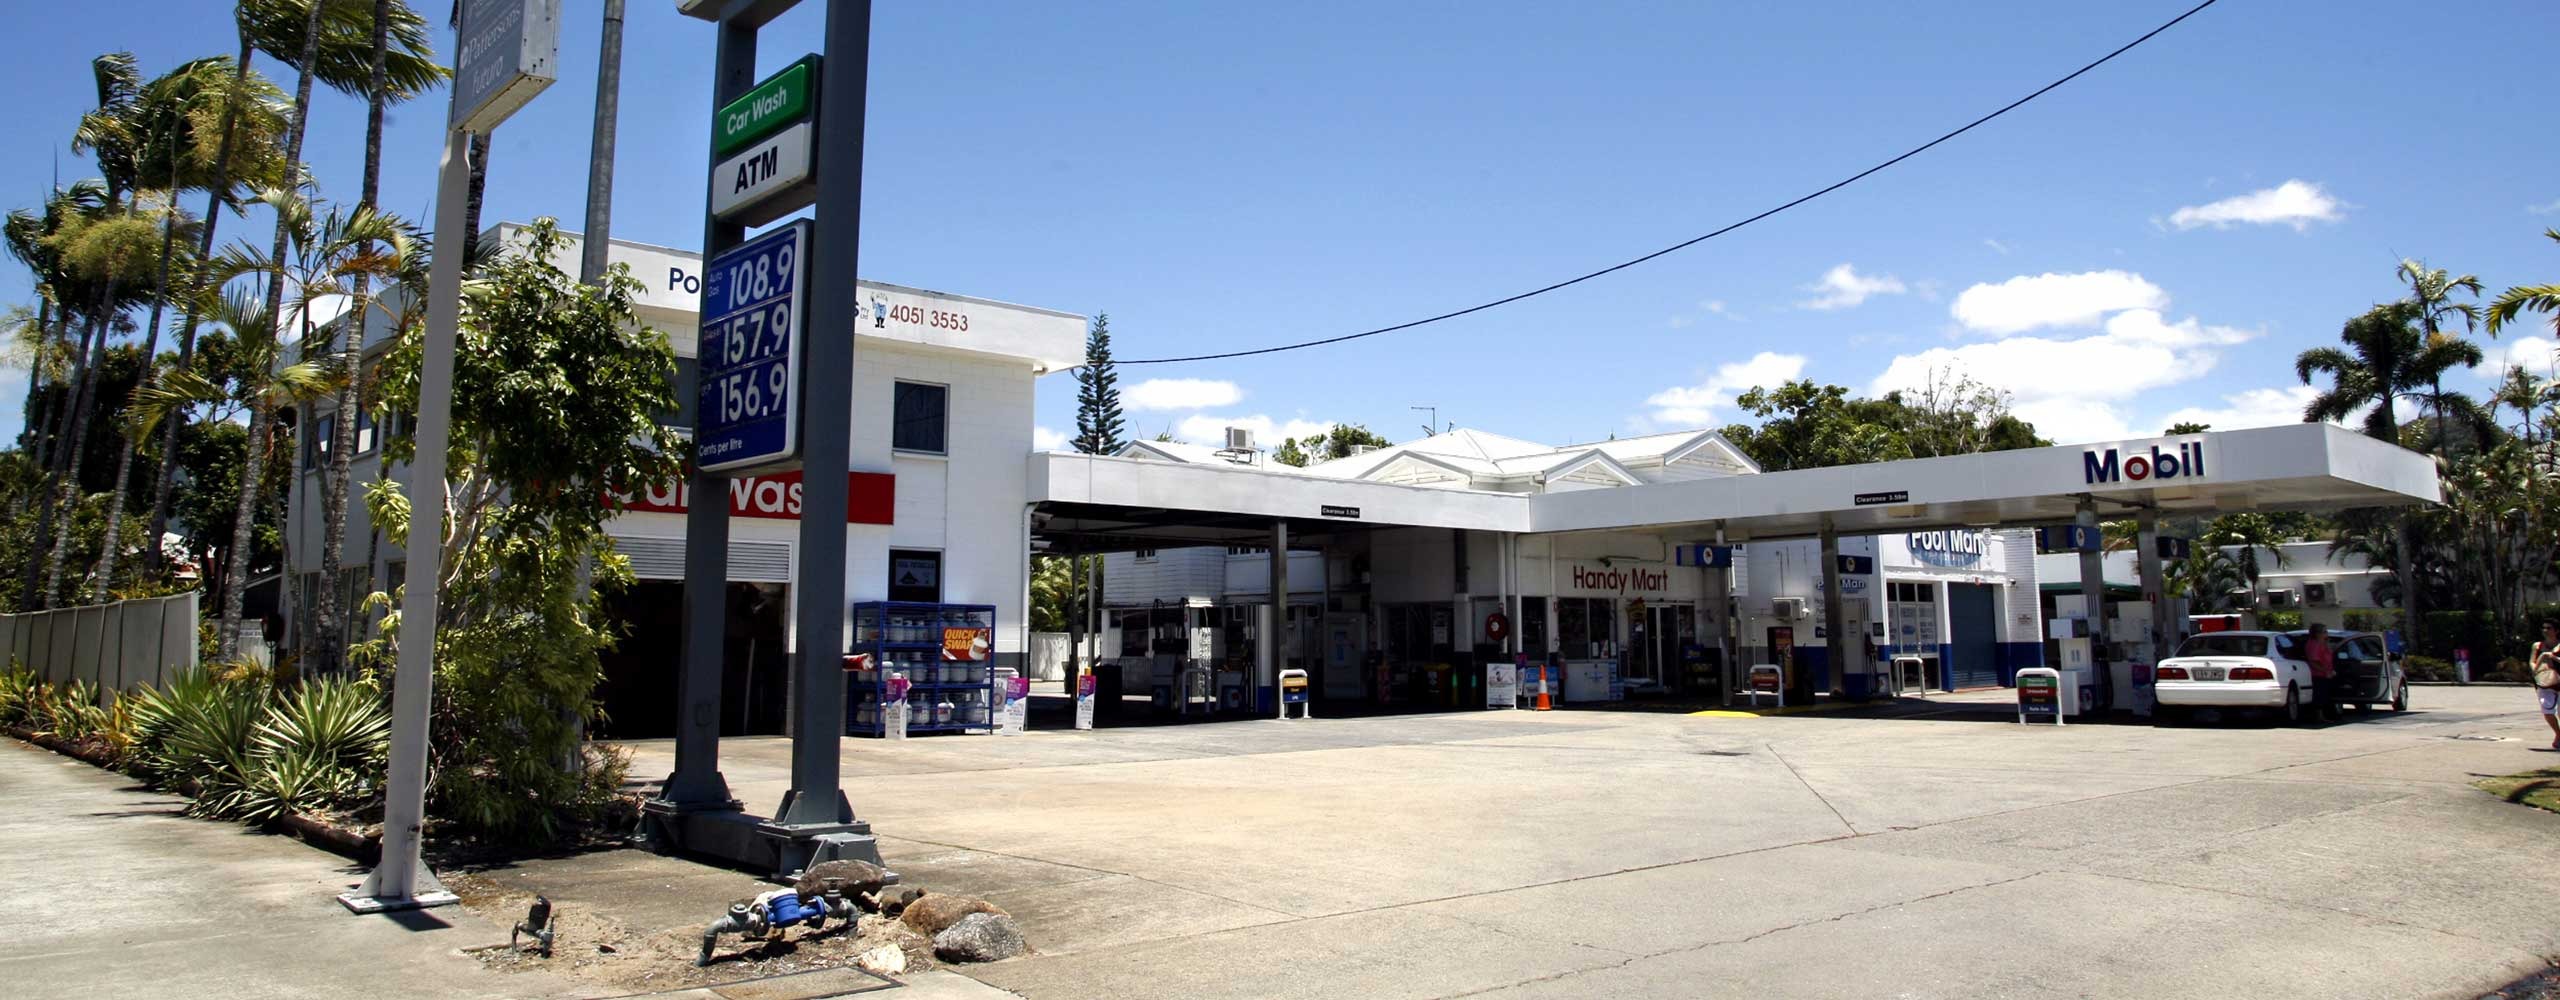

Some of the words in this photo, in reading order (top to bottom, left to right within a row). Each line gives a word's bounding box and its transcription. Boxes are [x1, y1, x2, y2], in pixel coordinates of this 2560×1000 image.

[727, 110, 749, 135] Car
[752, 86, 787, 122] Wash
[734, 145, 778, 195] ATM
[728, 243, 793, 310] 108.9
[722, 302, 789, 366] 157.9
[889, 304, 924, 325] 4051
[930, 310, 969, 332] 3553
[720, 362, 787, 423] 156.9
[699, 444, 717, 457] Cents
[717, 442, 729, 456] per
[729, 438, 743, 451] litre
[2083, 441, 2205, 484] Mobil
[729, 476, 803, 514] Was
[1911, 530, 1947, 552] Pool
[1950, 529, 1983, 555] Man
[1573, 565, 1628, 596] Handy
[1632, 567, 1668, 592] Mart
[944, 628, 976, 640] QUICK
